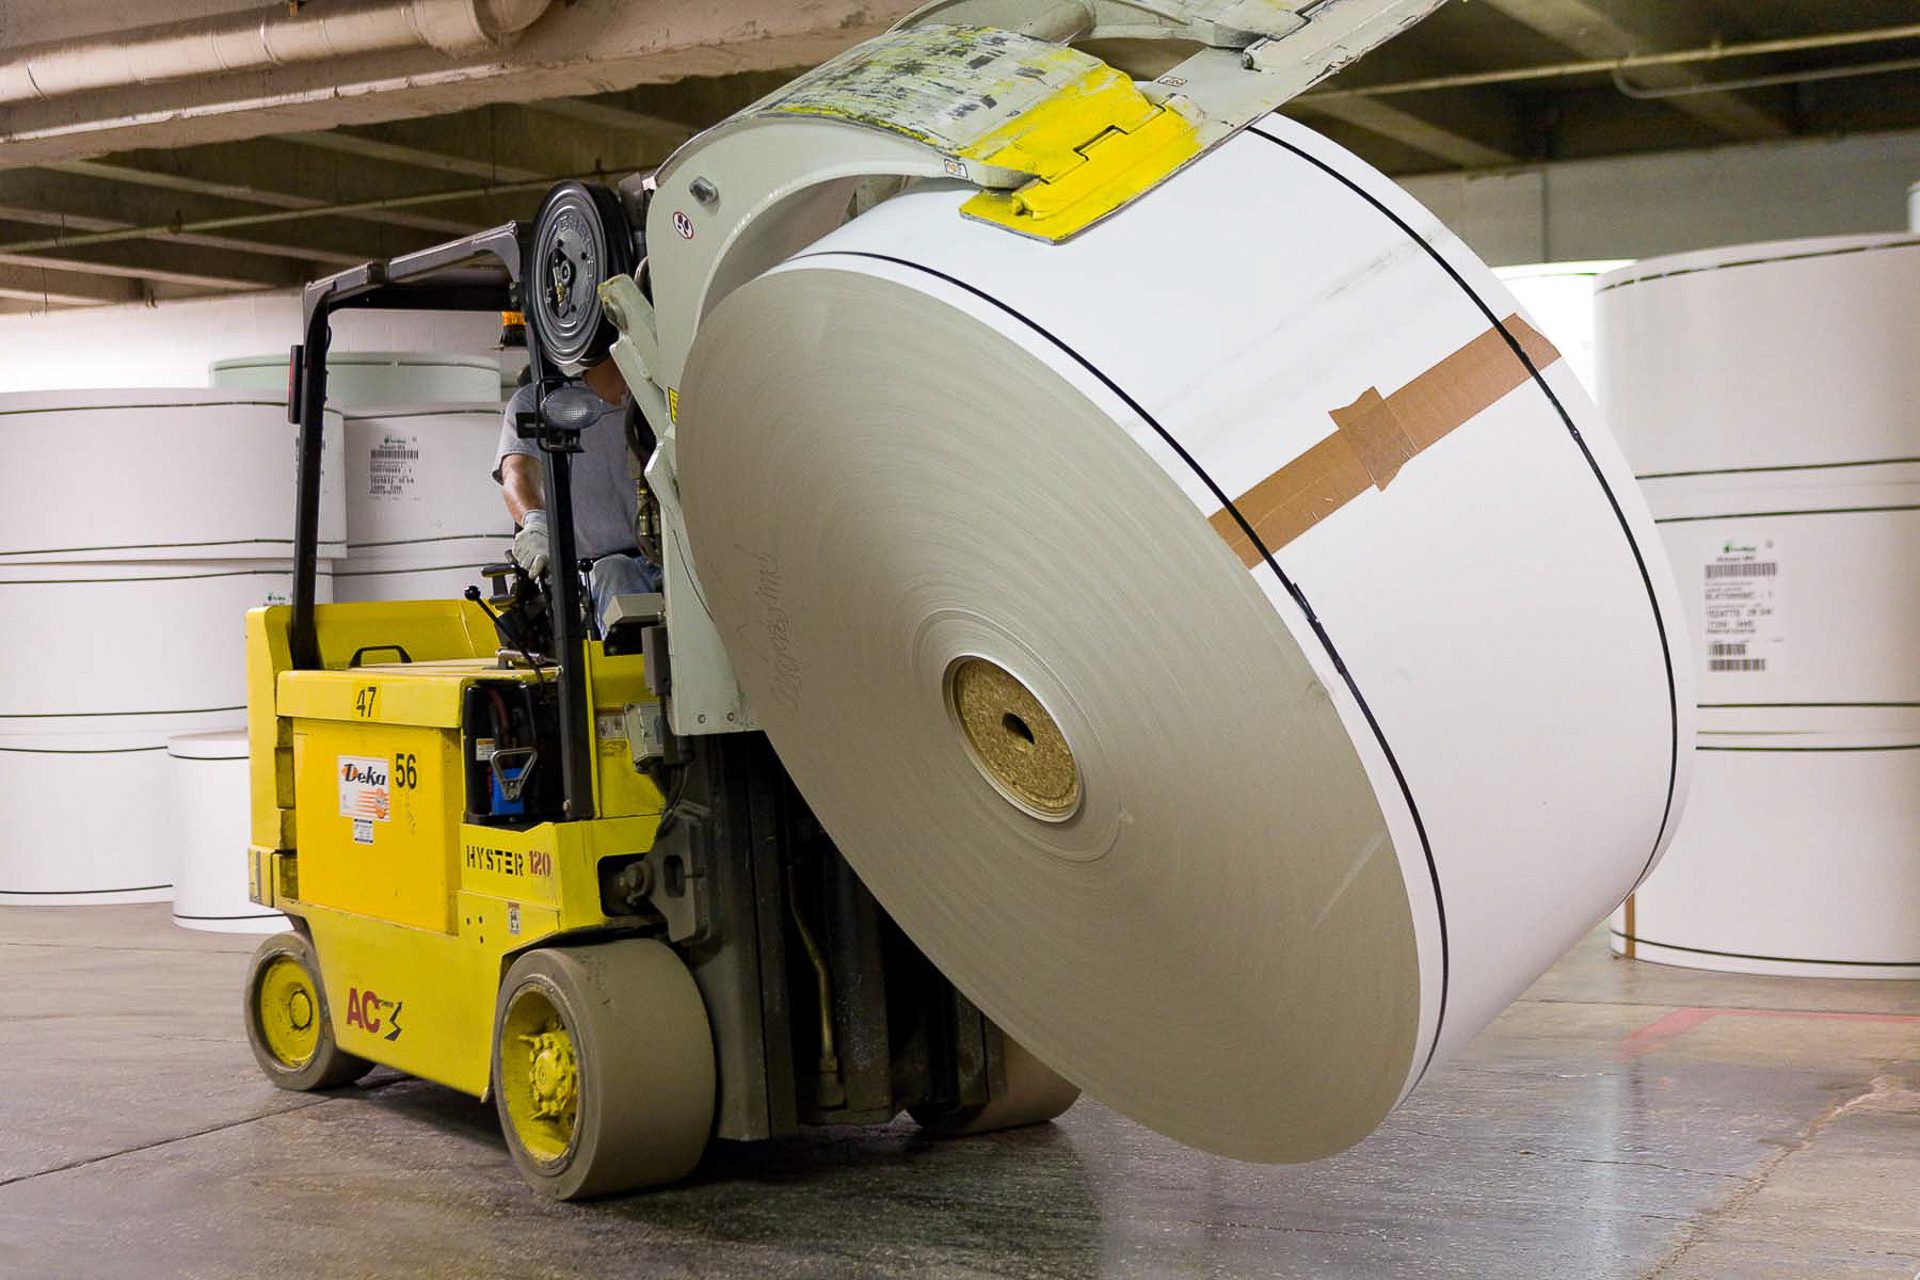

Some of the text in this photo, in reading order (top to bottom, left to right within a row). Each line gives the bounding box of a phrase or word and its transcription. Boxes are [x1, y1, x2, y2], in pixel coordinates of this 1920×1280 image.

[356, 686, 377, 718] 47
[342, 762, 386, 786] Deka
[395, 752, 417, 790] 56
[466, 844, 552, 877] HYSTER 120
